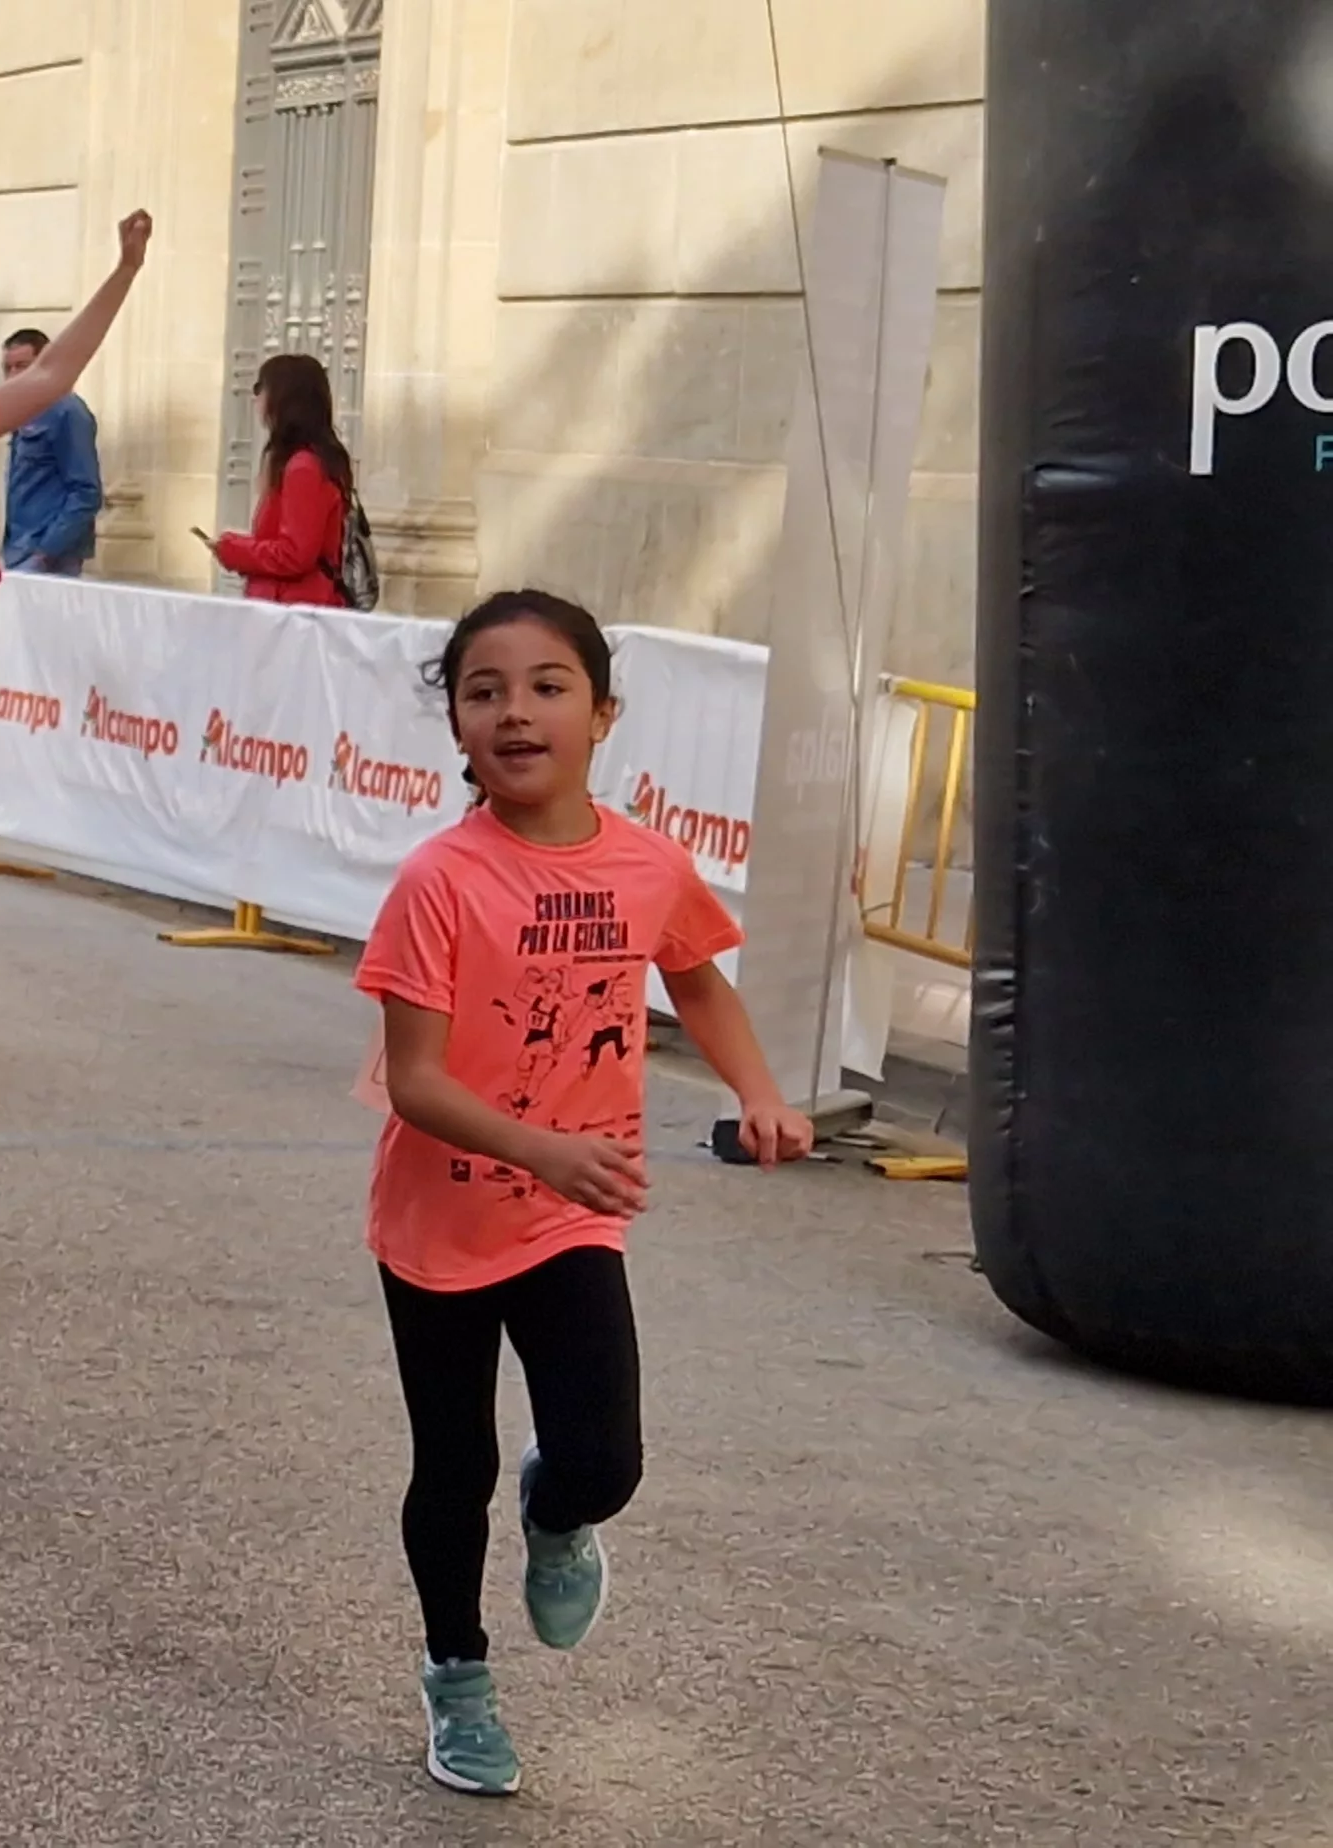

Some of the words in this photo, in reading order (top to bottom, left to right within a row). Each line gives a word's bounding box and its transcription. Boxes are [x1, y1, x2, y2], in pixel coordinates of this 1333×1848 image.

[80, 685, 179, 761] Alcampo
[200, 707, 308, 790] Alcampo
[328, 731, 442, 817] Alcampo
[517, 924, 550, 956] POR
[552, 923, 569, 953] LA
[535, 890, 615, 922] CORRAMOS
